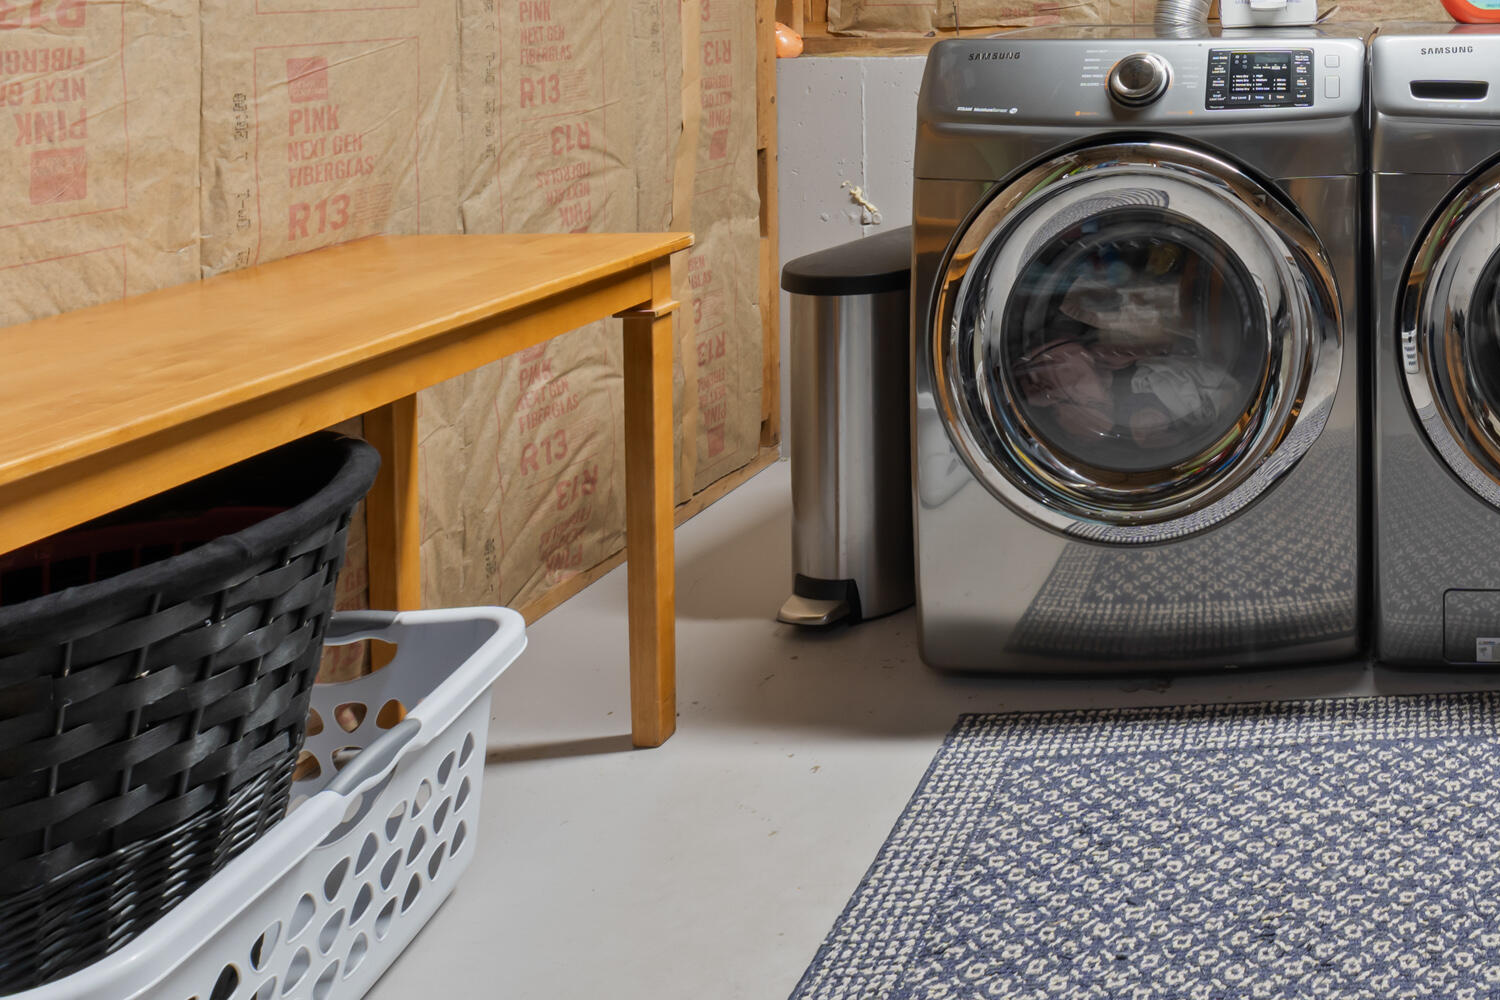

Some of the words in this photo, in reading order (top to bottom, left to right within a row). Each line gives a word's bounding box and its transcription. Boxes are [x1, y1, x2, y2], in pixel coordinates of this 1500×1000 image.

[519, 0, 551, 22] PINK
[520, 26, 545, 44] NEXT
[547, 24, 566, 41] GEN
[520, 44, 573, 65] FIBERGLAS
[703, 40, 732, 67] R13
[968, 51, 1021, 61] SAMSUNG
[1421, 46, 1474, 56] SAMSUNG
[33, 76, 86, 106] NEXT
[519, 74, 561, 109] R13
[14, 107, 87, 149] PINK
[288, 103, 340, 137] PINK
[288, 137, 327, 163] NEXT
[333, 132, 364, 155] GEN
[551, 121, 591, 156] R13
[288, 154, 376, 189] FIBERGLAS
[535, 162, 592, 188] FIBERGLAS
[287, 193, 351, 241] R13
[559, 203, 593, 230] PINK
[697, 331, 726, 367] R13
[520, 358, 552, 390] PINK
[519, 393, 580, 434] FIBERGLAS
[520, 429, 569, 476] R13
[556, 464, 598, 511] R13
